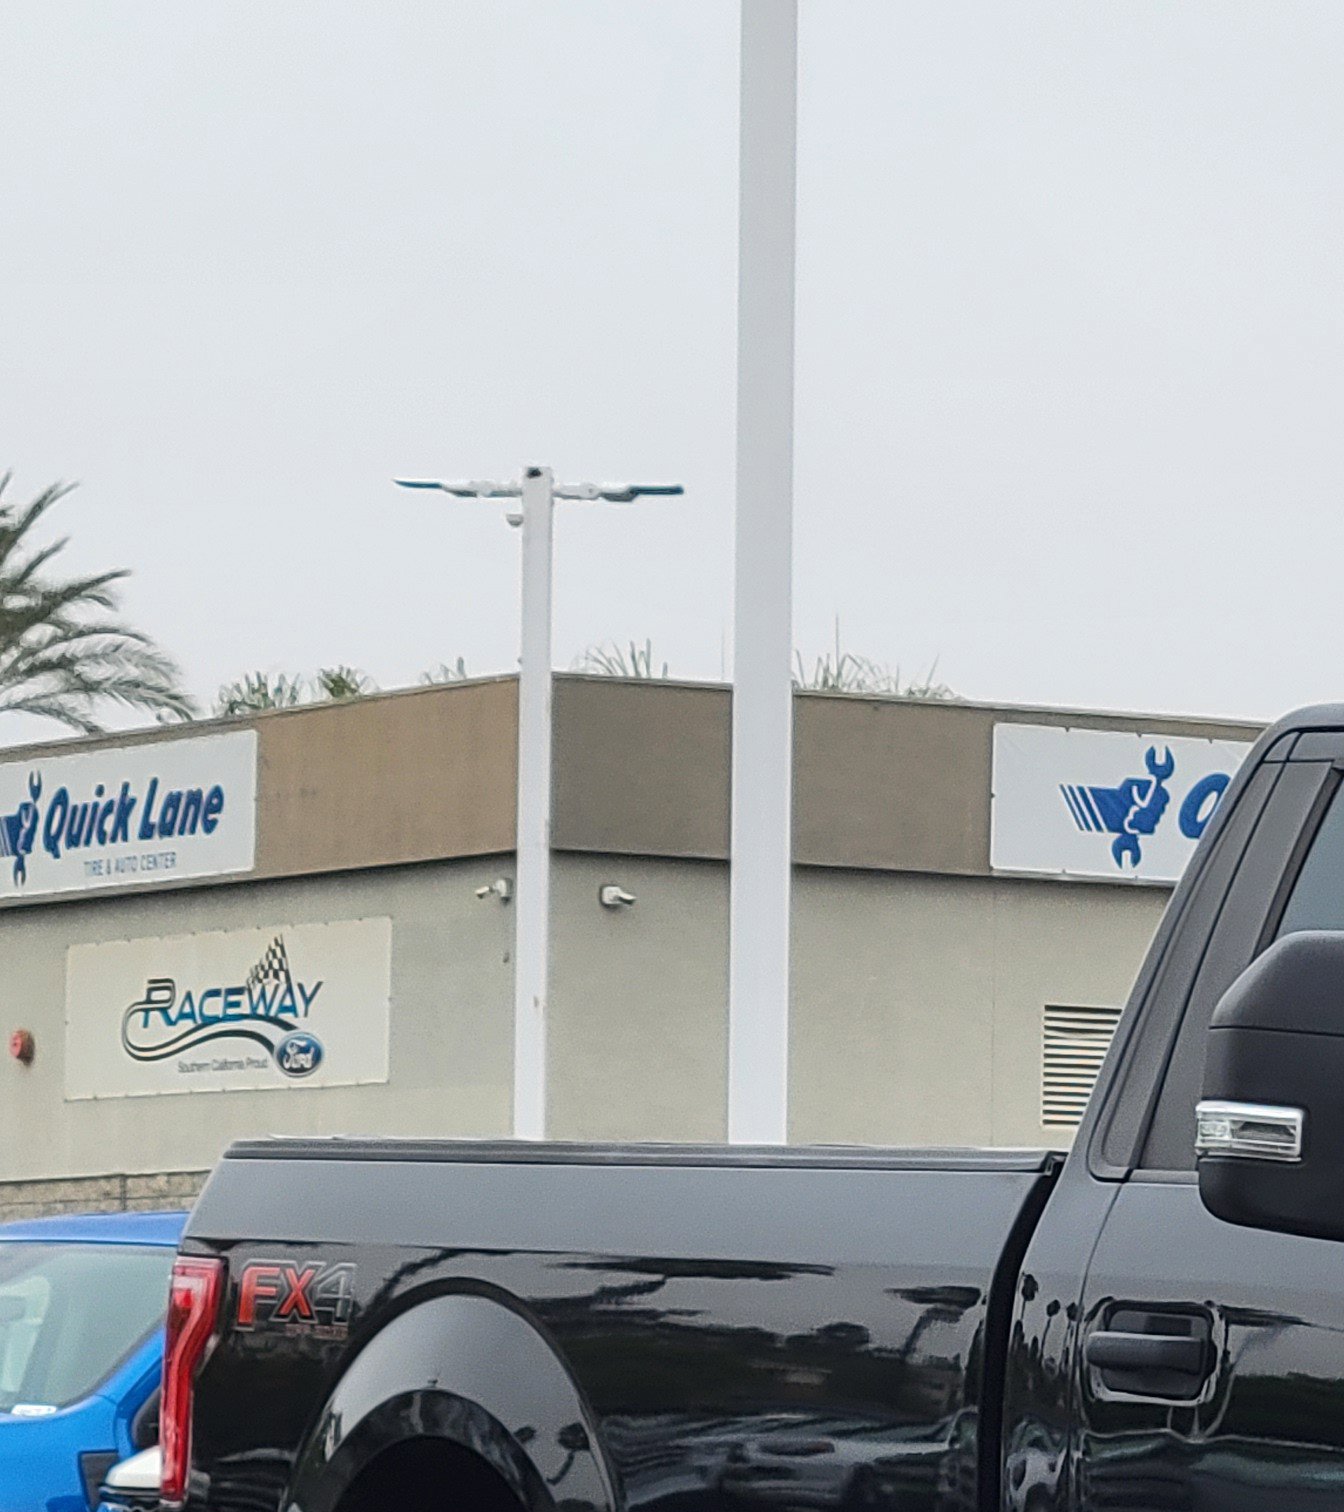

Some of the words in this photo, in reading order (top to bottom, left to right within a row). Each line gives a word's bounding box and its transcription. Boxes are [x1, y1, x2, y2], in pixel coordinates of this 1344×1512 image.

[43, 781, 136, 859] Quick
[138, 777, 224, 840] Lane
[84, 858, 103, 876] TIRE
[115, 855, 137, 873] AUTO
[140, 852, 176, 871] CENTER
[140, 978, 324, 1028] RACEWAY
[283, 1039, 315, 1070] Ford
[233, 1258, 357, 1332] FX4
